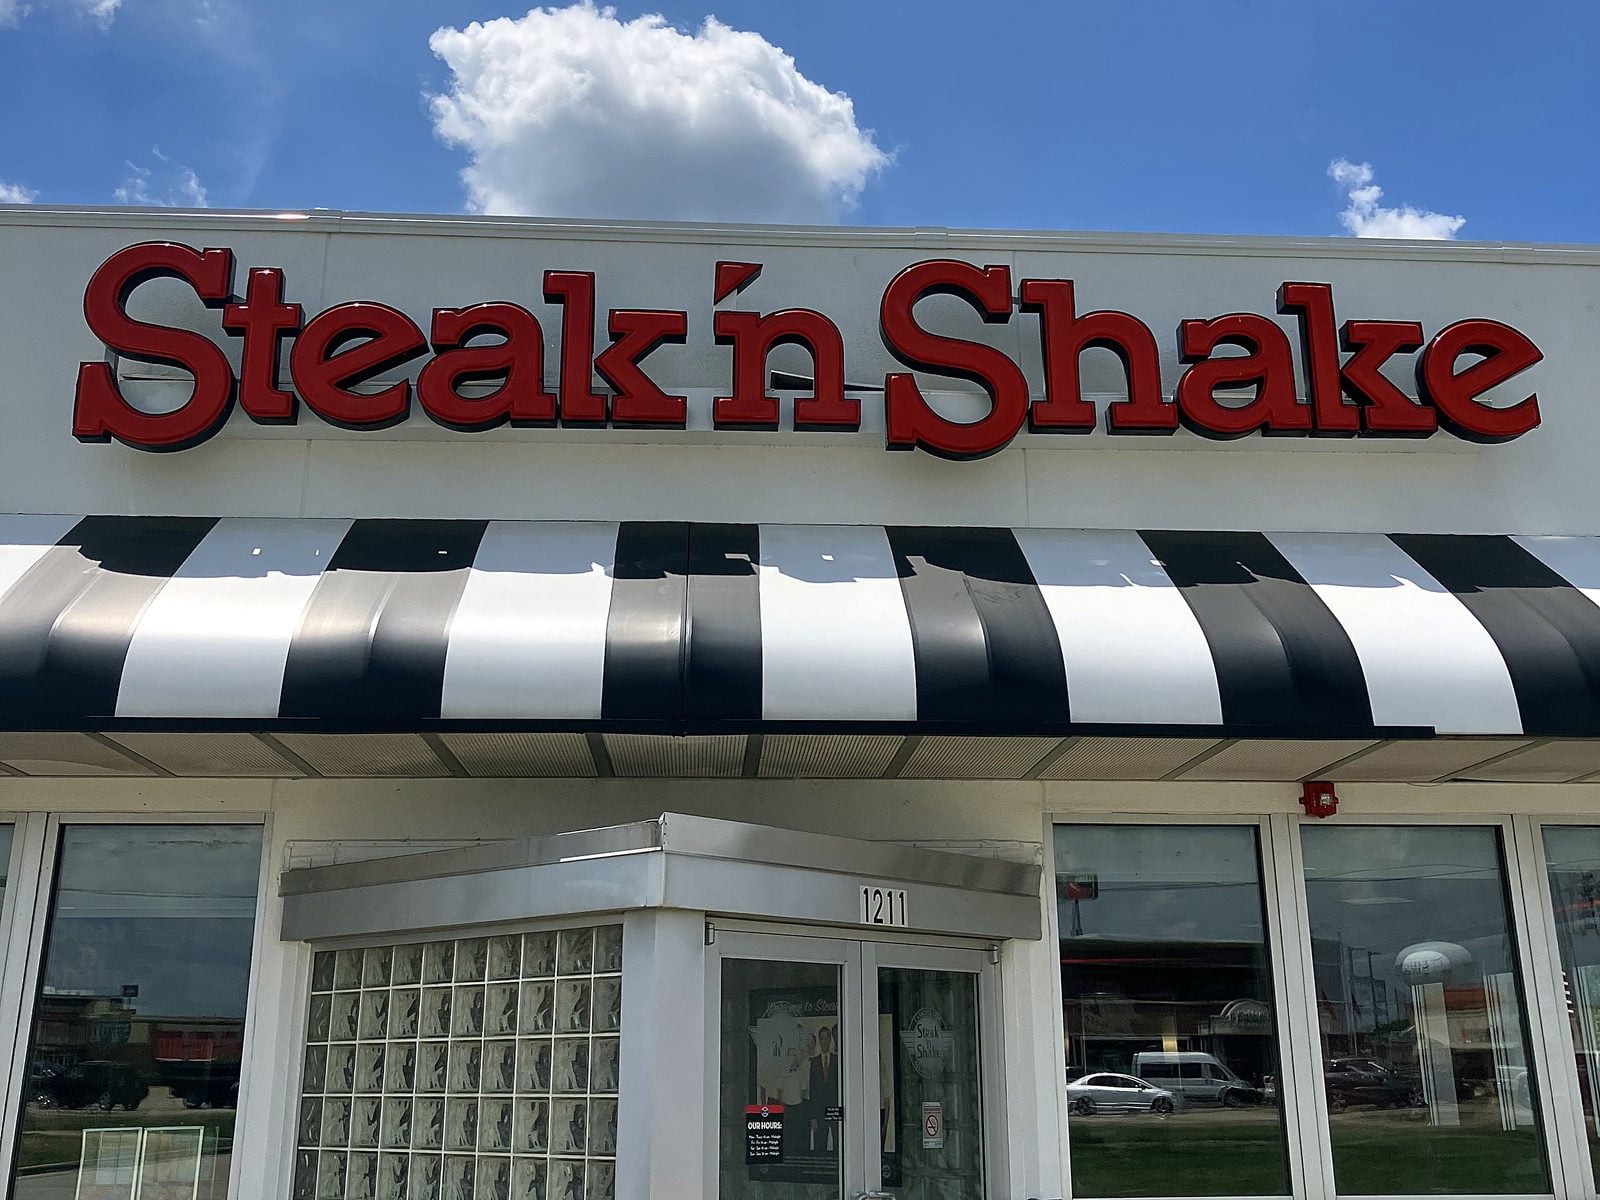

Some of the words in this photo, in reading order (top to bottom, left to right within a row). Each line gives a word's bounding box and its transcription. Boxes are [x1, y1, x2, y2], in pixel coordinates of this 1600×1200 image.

[73, 241, 687, 453] Steak
[880, 258, 1543, 461] Shake
[863, 888, 904, 925] 1211
[917, 1024, 939, 1039] Steak
[916, 1044, 940, 1059] Shake
[747, 1121, 760, 1130] OUR
